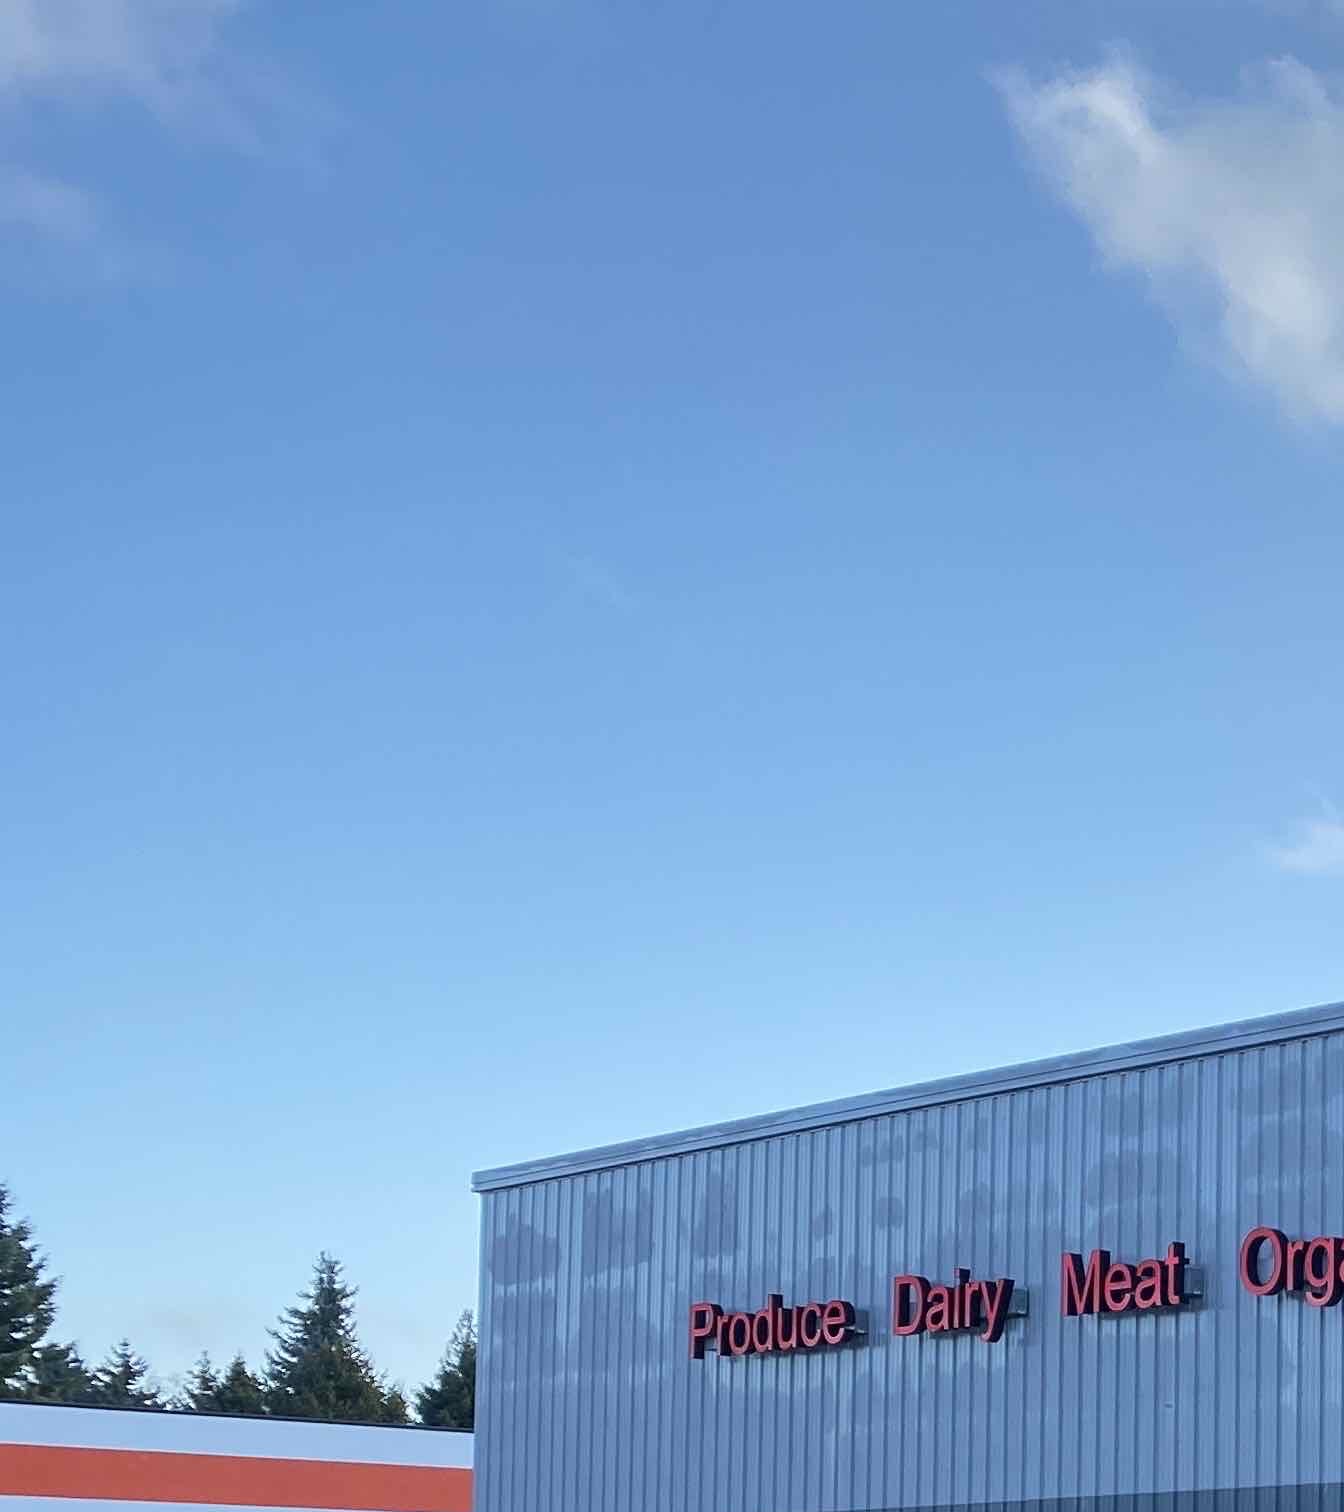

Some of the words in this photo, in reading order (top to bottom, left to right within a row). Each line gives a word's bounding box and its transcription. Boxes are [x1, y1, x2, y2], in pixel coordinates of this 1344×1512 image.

[689, 1293, 856, 1360] Produce
[893, 1267, 1015, 1343] Dairy
[1061, 1242, 1187, 1316] Meat
